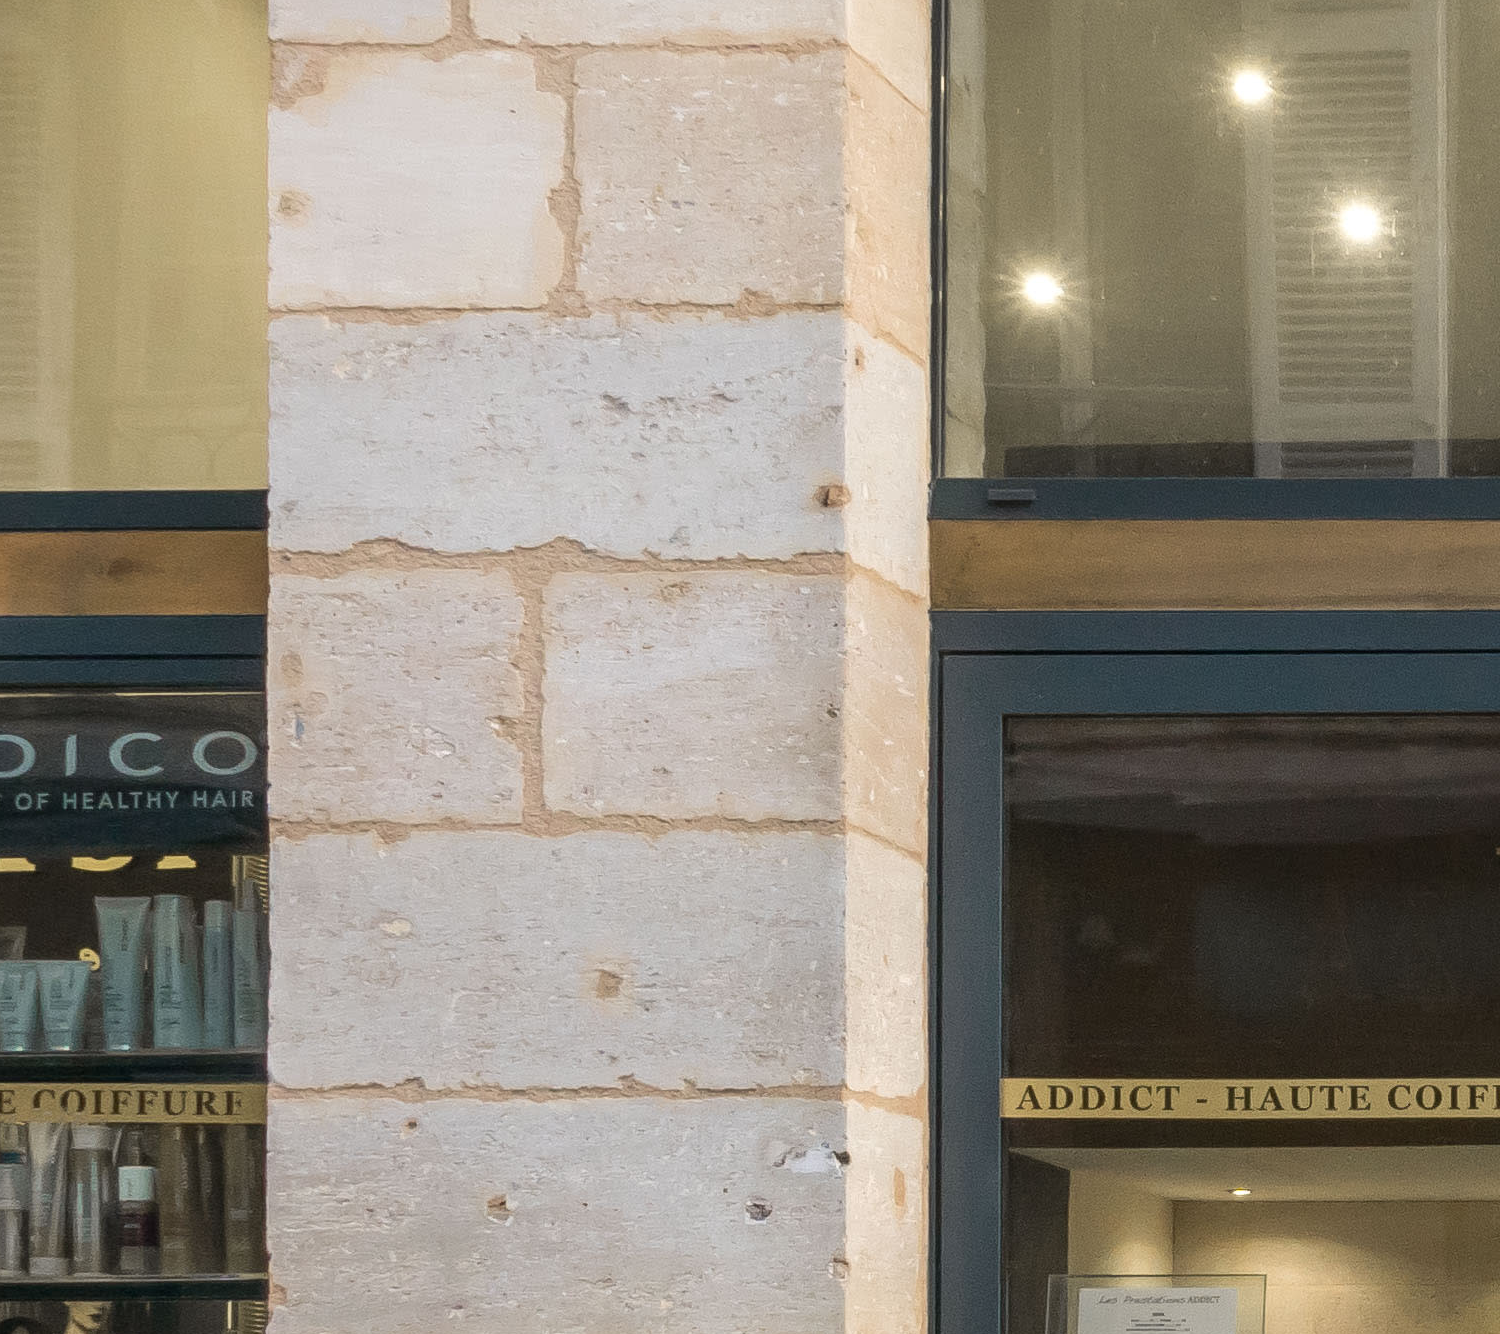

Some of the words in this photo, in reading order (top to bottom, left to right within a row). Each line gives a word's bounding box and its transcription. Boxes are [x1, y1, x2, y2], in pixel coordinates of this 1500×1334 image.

[15, 792, 49, 811] OF
[62, 790, 179, 810] HEALTHY
[192, 789, 255, 808] HAIR
[33, 1089, 244, 1115] COIFFURE
[1015, 1084, 1180, 1112] ADDICT
[1225, 1084, 1372, 1112] HAUTE
